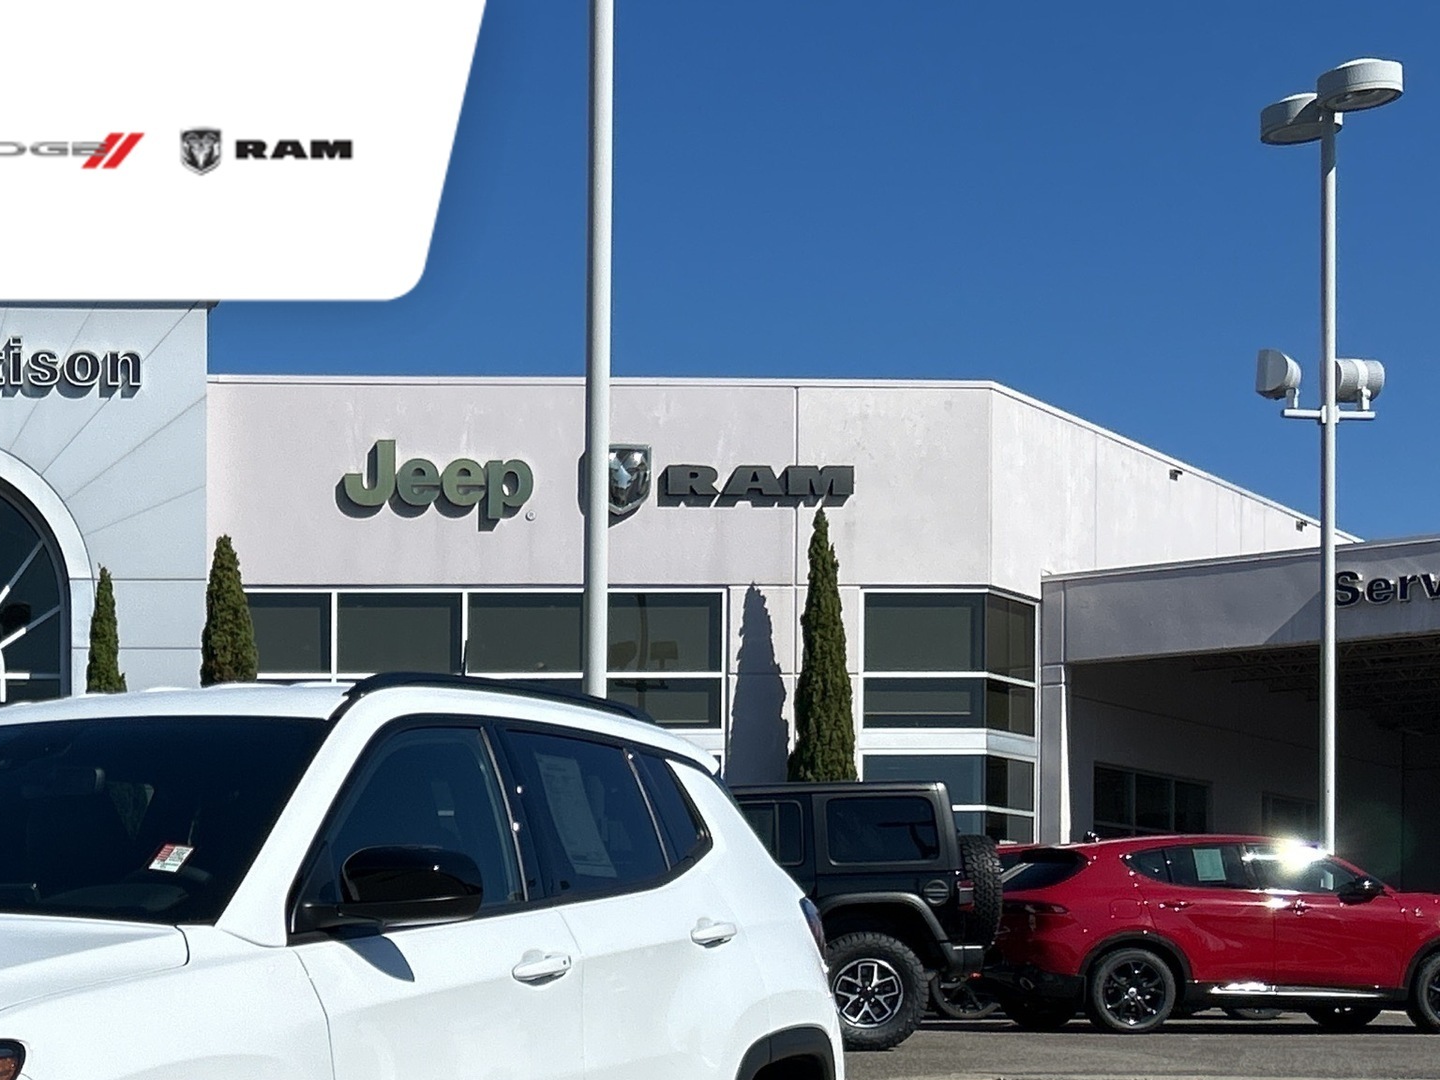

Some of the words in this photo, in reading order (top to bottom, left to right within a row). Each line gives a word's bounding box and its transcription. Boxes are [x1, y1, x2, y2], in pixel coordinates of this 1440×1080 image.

[344, 439, 535, 520] Jeep
[666, 464, 856, 497] RAM
[1334, 570, 1440, 609] Serv
